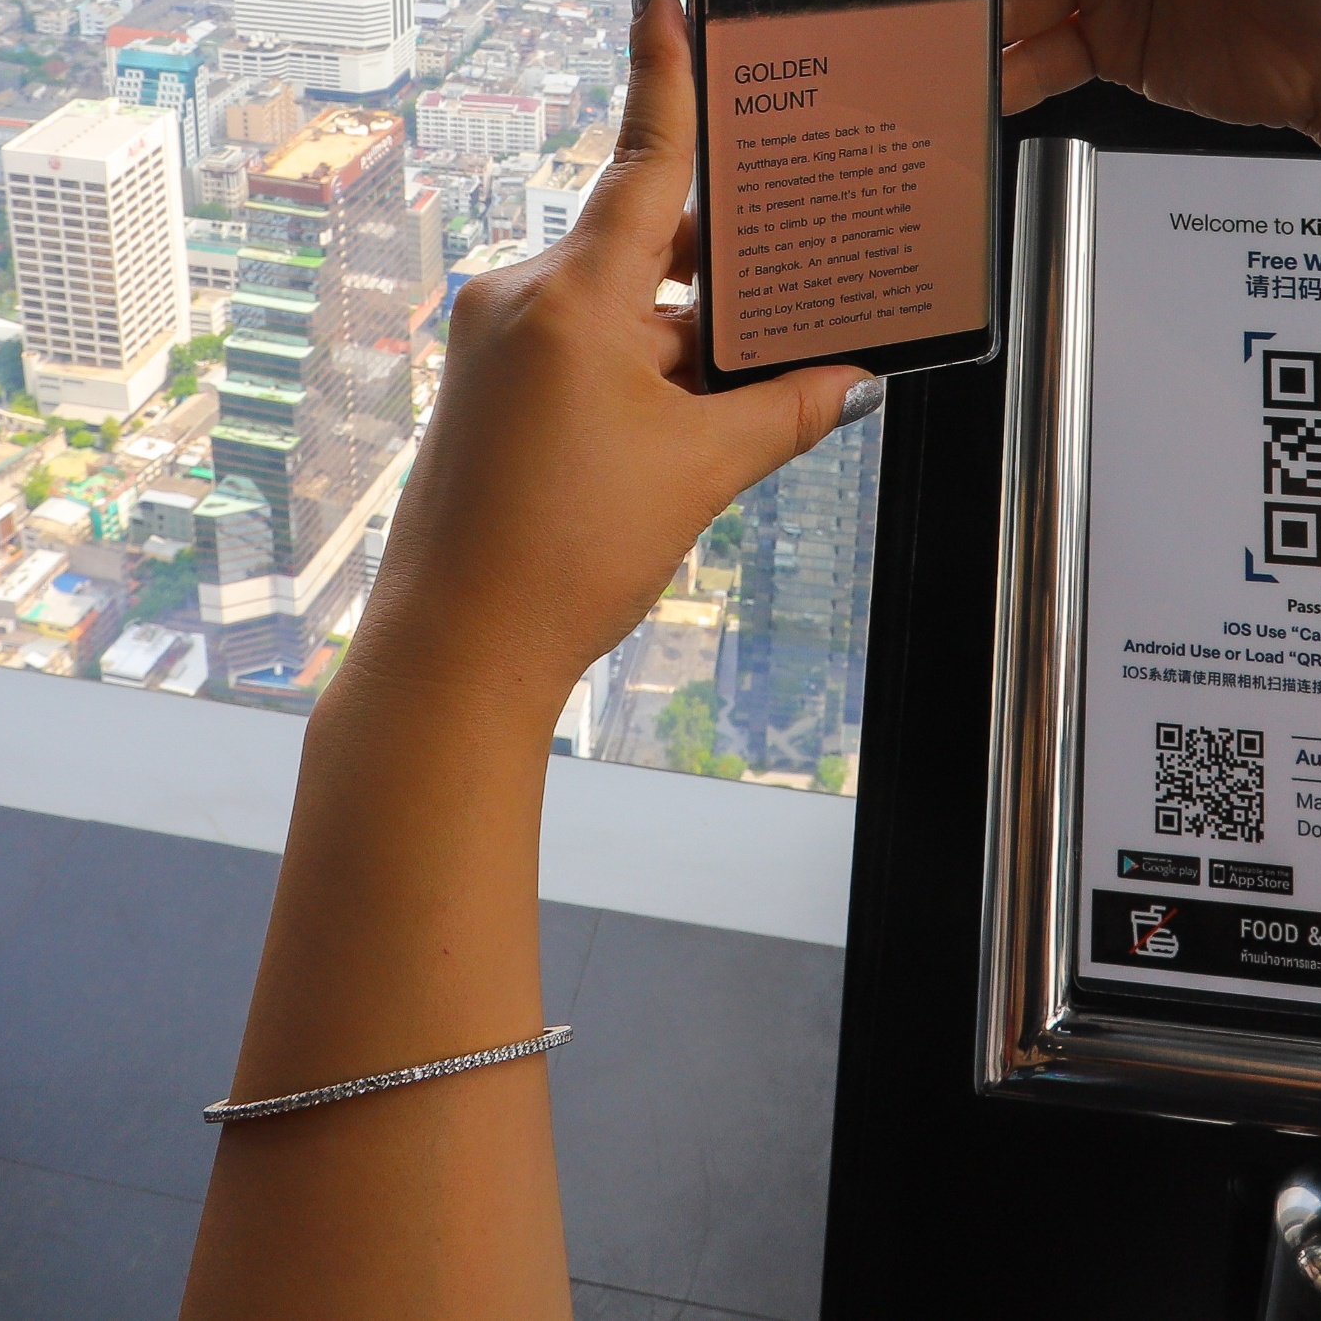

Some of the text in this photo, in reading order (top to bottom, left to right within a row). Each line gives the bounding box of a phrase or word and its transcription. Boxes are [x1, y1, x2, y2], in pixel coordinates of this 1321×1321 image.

[734, 56, 827, 84] GOLDEN
[735, 88, 818, 115] MOUNT
[736, 122, 895, 149] The temple dates back to the
[736, 157, 788, 173] Ayutthaya
[790, 155, 810, 164] era.
[813, 151, 836, 162] King
[838, 147, 867, 158] Rama
[878, 143, 887, 153] is
[891, 141, 907, 151] the
[911, 139, 930, 148] one
[737, 161, 925, 193] who renovated the temple and gave
[737, 204, 743, 214] it
[748, 203, 761, 213] its
[766, 197, 805, 213] present
[861, 187, 877, 197] fun
[882, 184, 897, 194] for
[901, 182, 916, 192] the
[737, 203, 911, 236] kids to climb up the mount while
[1169, 212, 1268, 234] Welcome
[1273, 217, 1293, 235] to
[738, 223, 920, 257] adults can enjoy a panoramic view
[738, 243, 912, 278] of Bangkok. An annual festival is
[1247, 250, 1297, 270] Free
[739, 301, 932, 340] can have fun at colourful thai temple
[1223, 621, 1251, 636] iOS
[1256, 624, 1286, 639] Use
[1123, 639, 1185, 656] Android
[1190, 644, 1220, 659] Use
[1224, 649, 1241, 660] or
[1245, 648, 1284, 664] Load
[1142, 861, 1198, 879] Google play
[1229, 873, 1290, 890] App Store
[1241, 918, 1298, 943] FOOD
